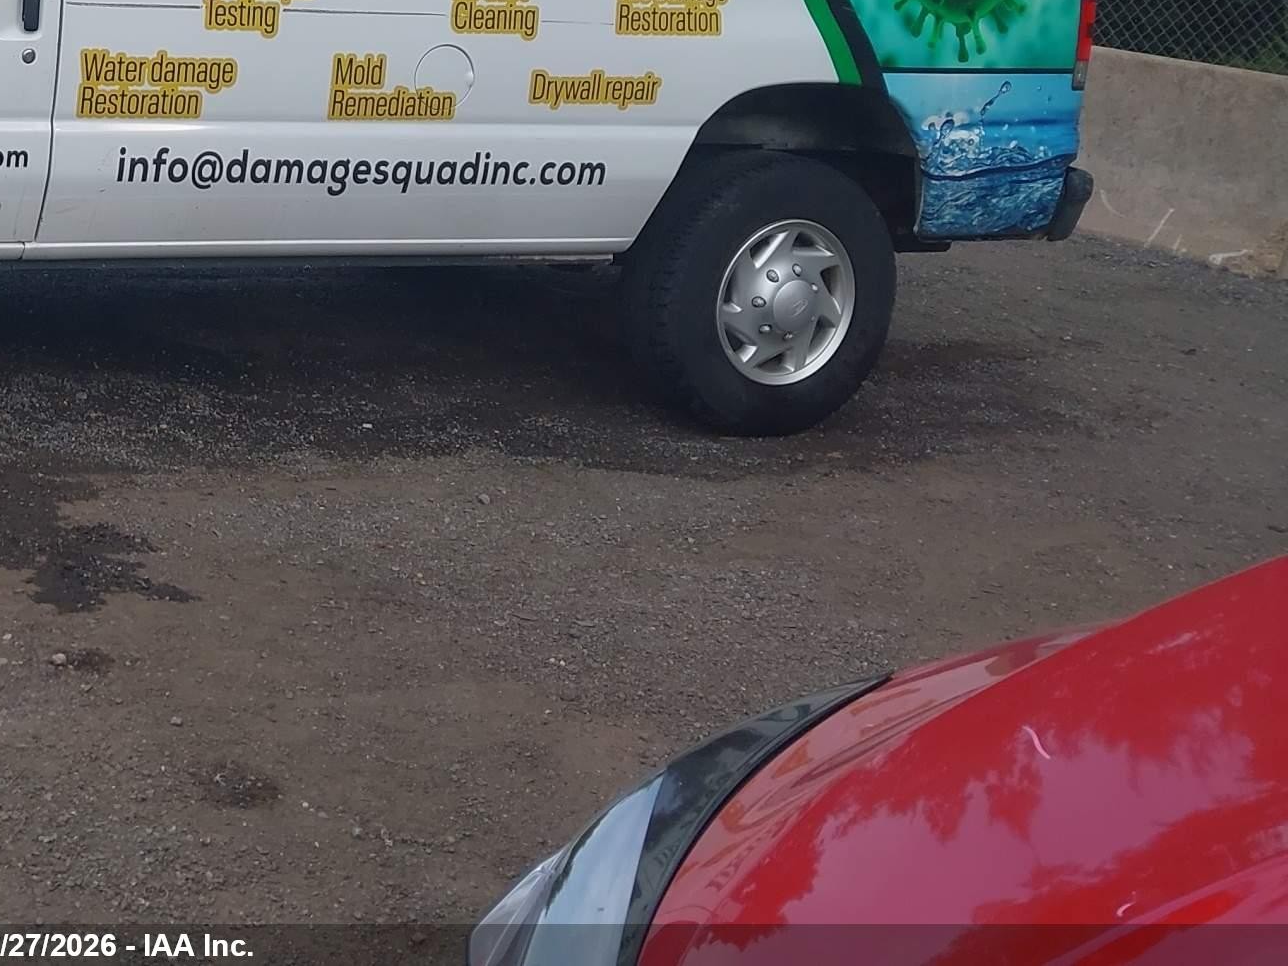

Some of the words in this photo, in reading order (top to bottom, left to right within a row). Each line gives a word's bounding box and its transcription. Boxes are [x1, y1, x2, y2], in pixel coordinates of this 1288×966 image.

[454, 1, 536, 36] Cleaning
[619, 4, 719, 32] Restoration
[84, 53, 146, 83] Water
[151, 55, 234, 89] damage
[335, 57, 383, 86] Mold
[80, 86, 199, 115] Restoration
[332, 89, 452, 117] Remediation
[533, 72, 600, 106] Drywall
[604, 74, 659, 107] repair
[116, 146, 606, 197] info@damagesquadinc.com
